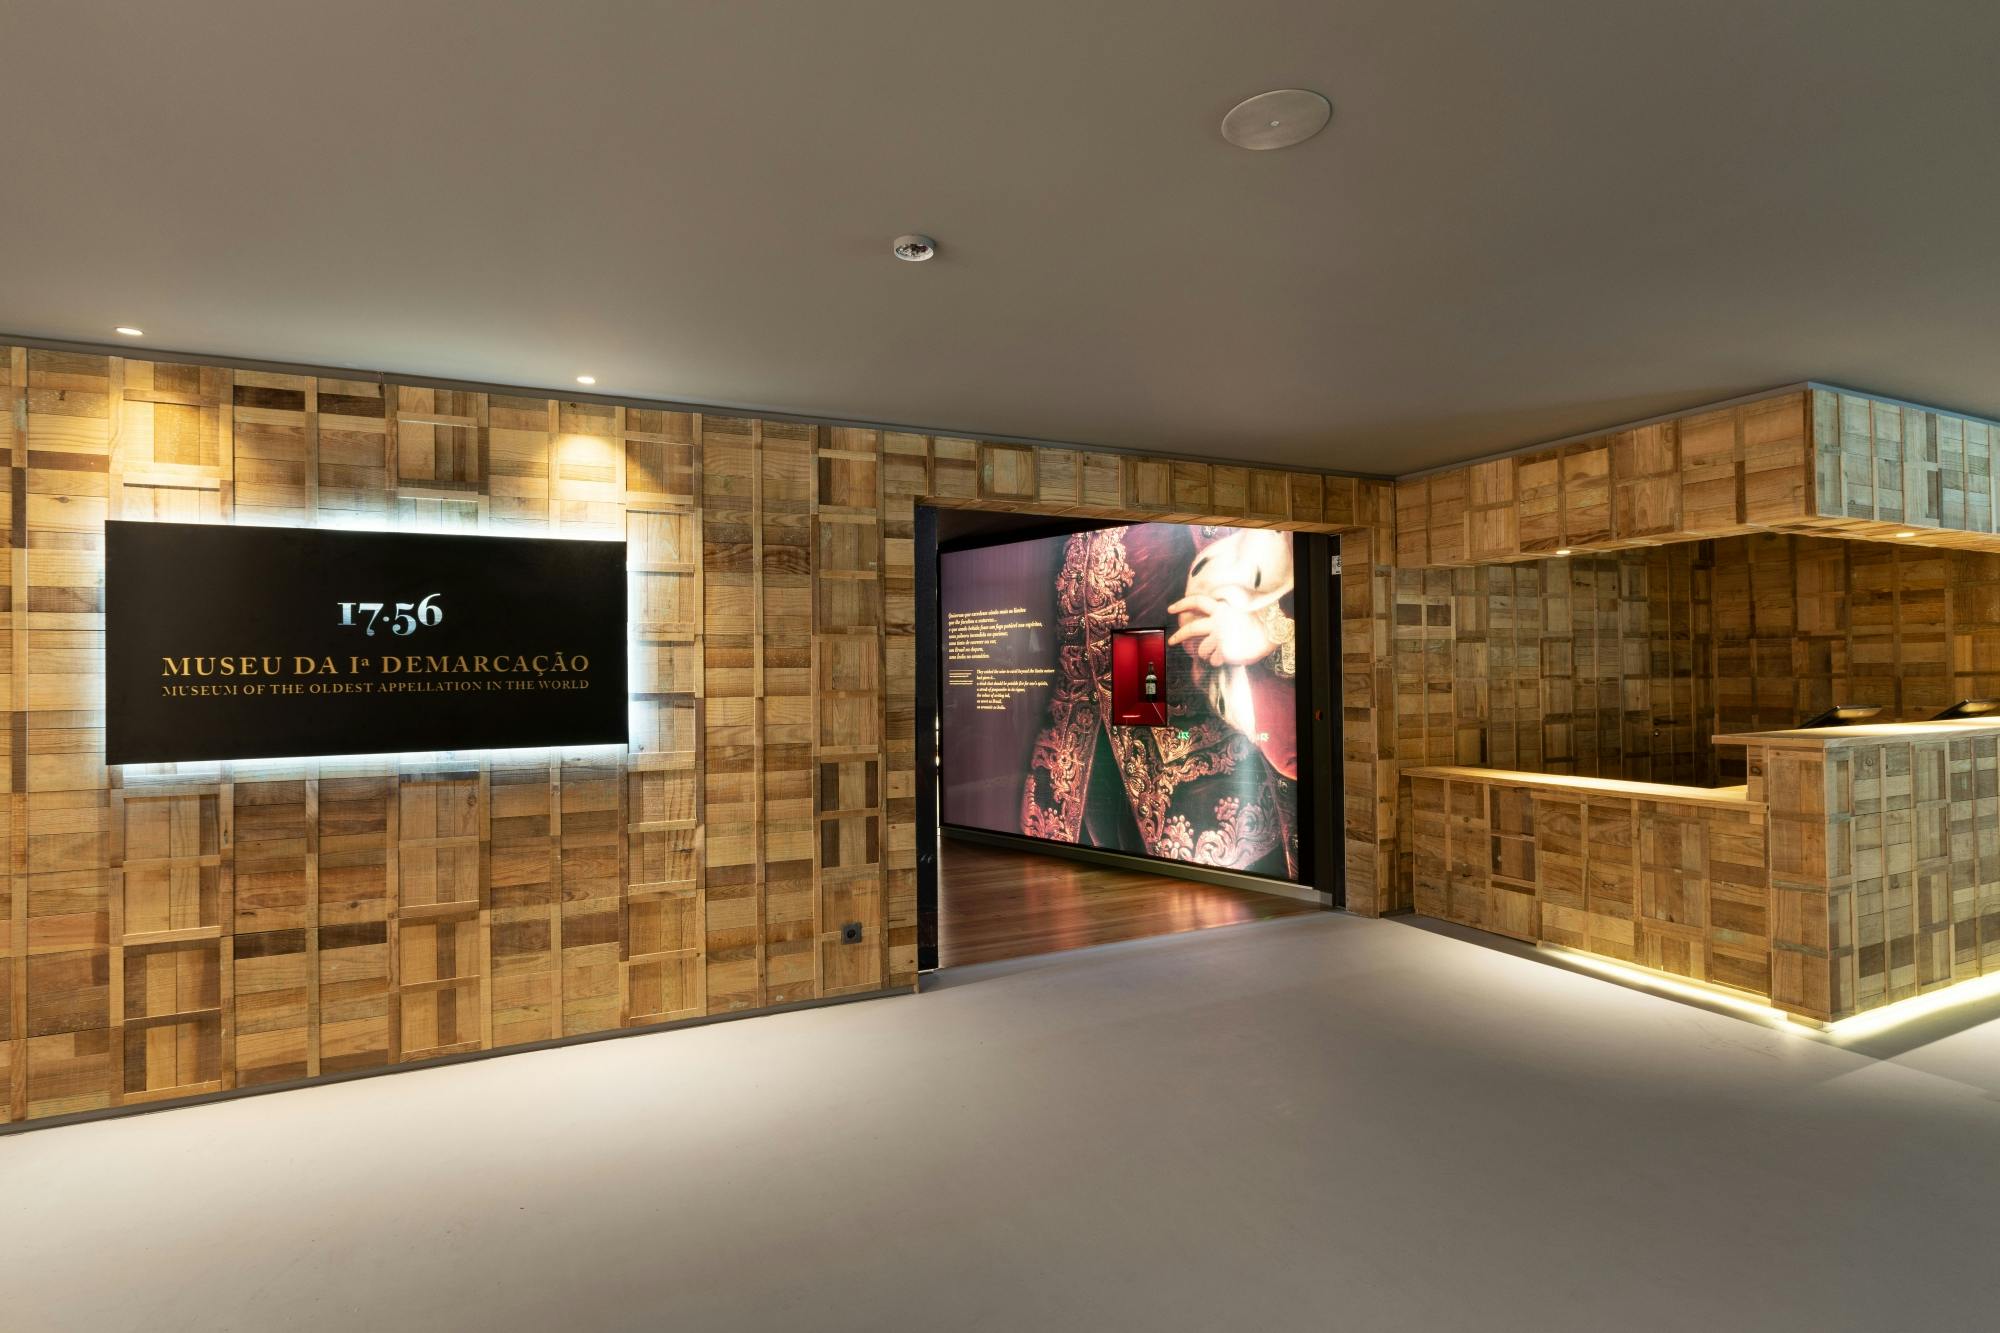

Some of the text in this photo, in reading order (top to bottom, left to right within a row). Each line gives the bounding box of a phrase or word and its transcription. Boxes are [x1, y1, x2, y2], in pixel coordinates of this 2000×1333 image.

[162, 657, 282, 676] MUSEU
[293, 656, 339, 675] DA
[381, 652, 589, 677] DEMARCAÇÃO
[162, 679, 590, 697] MUSEUM OF THE OLDEST APPELLATION IN THE WORLD
